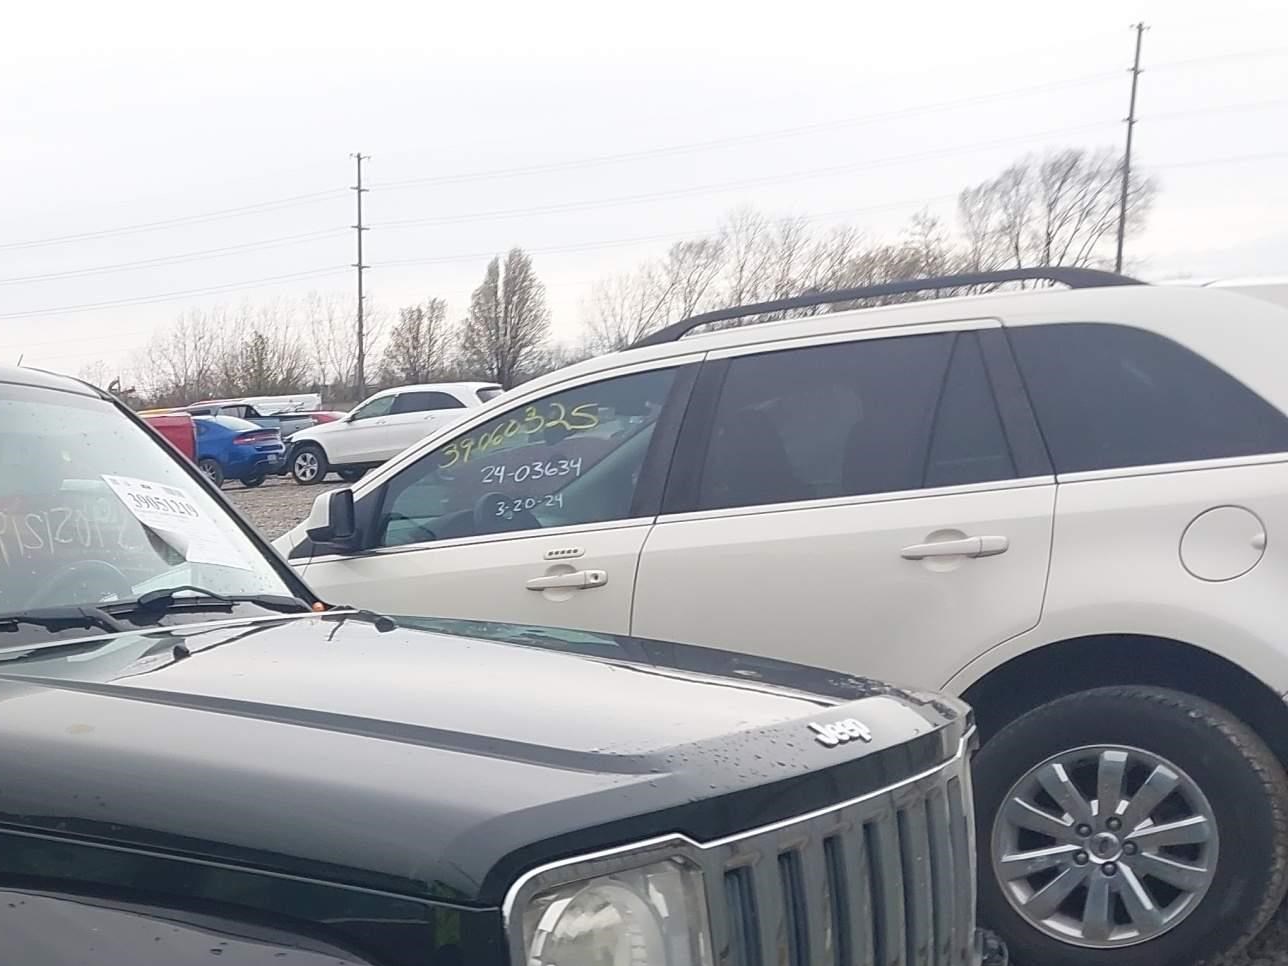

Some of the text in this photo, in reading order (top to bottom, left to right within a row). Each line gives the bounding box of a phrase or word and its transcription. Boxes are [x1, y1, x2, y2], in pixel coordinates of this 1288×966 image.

[439, 402, 599, 468] 39060325
[481, 458, 583, 484] 24-03634
[127, 492, 200, 518] 39051219
[495, 492, 564, 517] 3-20-24
[807, 718, 873, 749] Jeep
